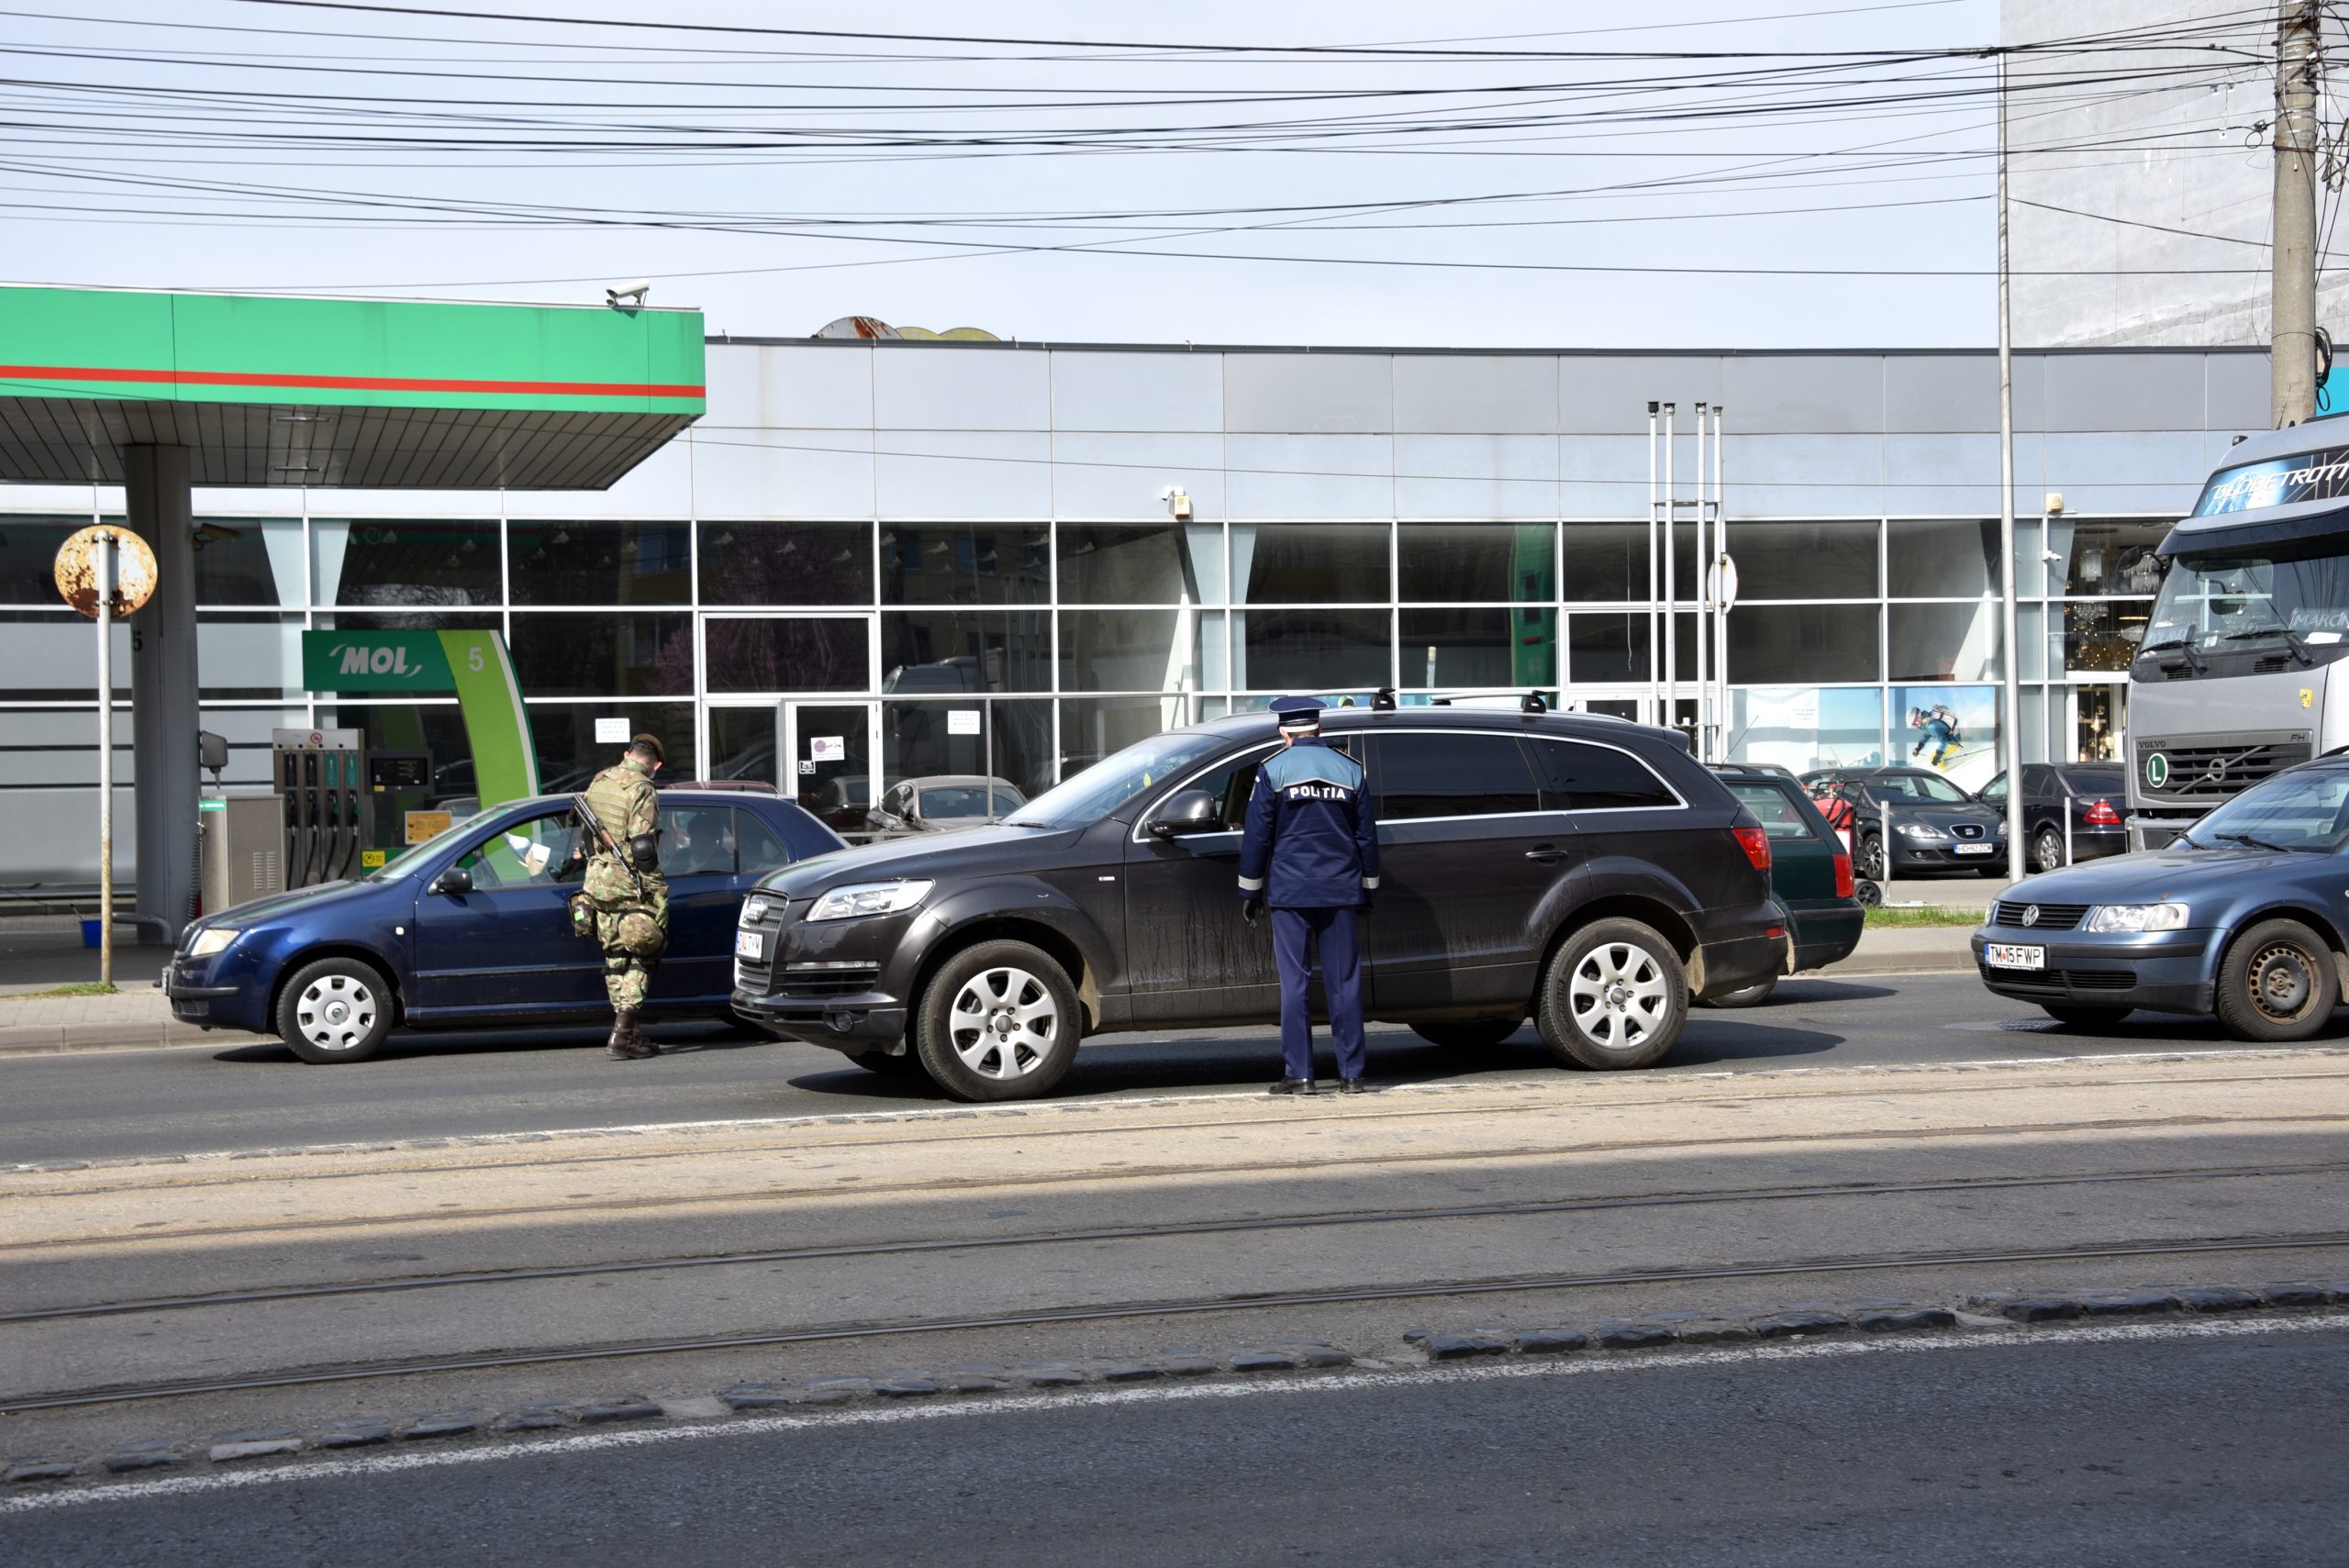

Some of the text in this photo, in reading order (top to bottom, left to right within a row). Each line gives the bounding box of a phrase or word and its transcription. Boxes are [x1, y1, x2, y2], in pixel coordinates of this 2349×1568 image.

[339, 646, 409, 674] MOL
[469, 646, 484, 673] 5
[2138, 740, 2166, 749] VOLVO
[2289, 734, 2306, 742] FH
